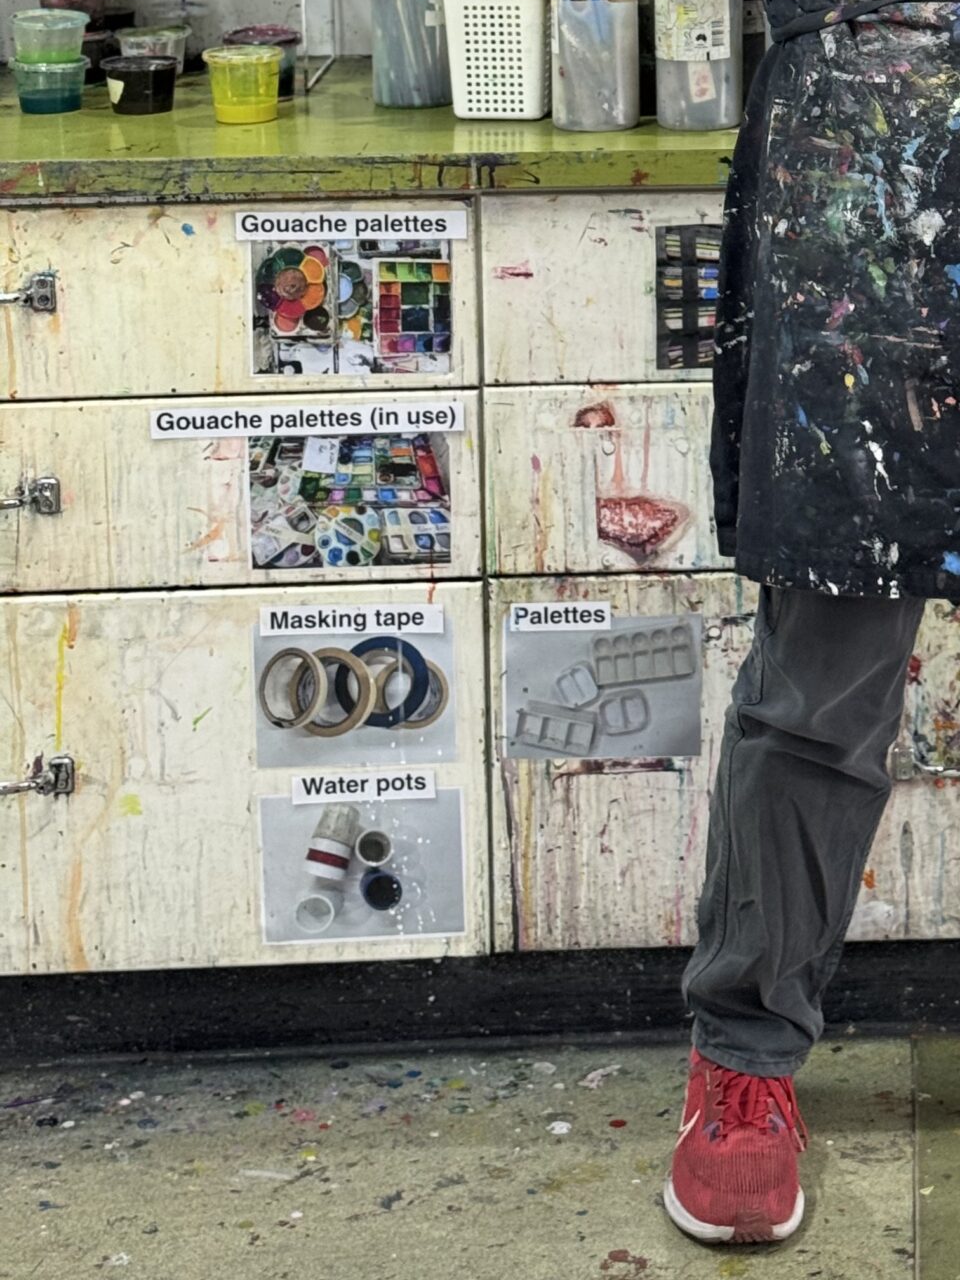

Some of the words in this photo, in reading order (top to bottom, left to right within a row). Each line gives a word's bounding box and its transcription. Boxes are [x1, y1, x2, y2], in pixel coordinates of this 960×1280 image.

[241, 214, 347, 233] Gouache
[355, 214, 447, 236] palettes
[156, 411, 262, 432] Gouache
[270, 409, 362, 432] palettes
[370, 407, 398, 430] (in
[407, 406, 456, 429] use)
[270, 608, 367, 631] Masking
[375, 610, 424, 630] tape
[515, 607, 606, 625] Palettes
[302, 775, 369, 796] Water
[376, 773, 427, 795] pots
